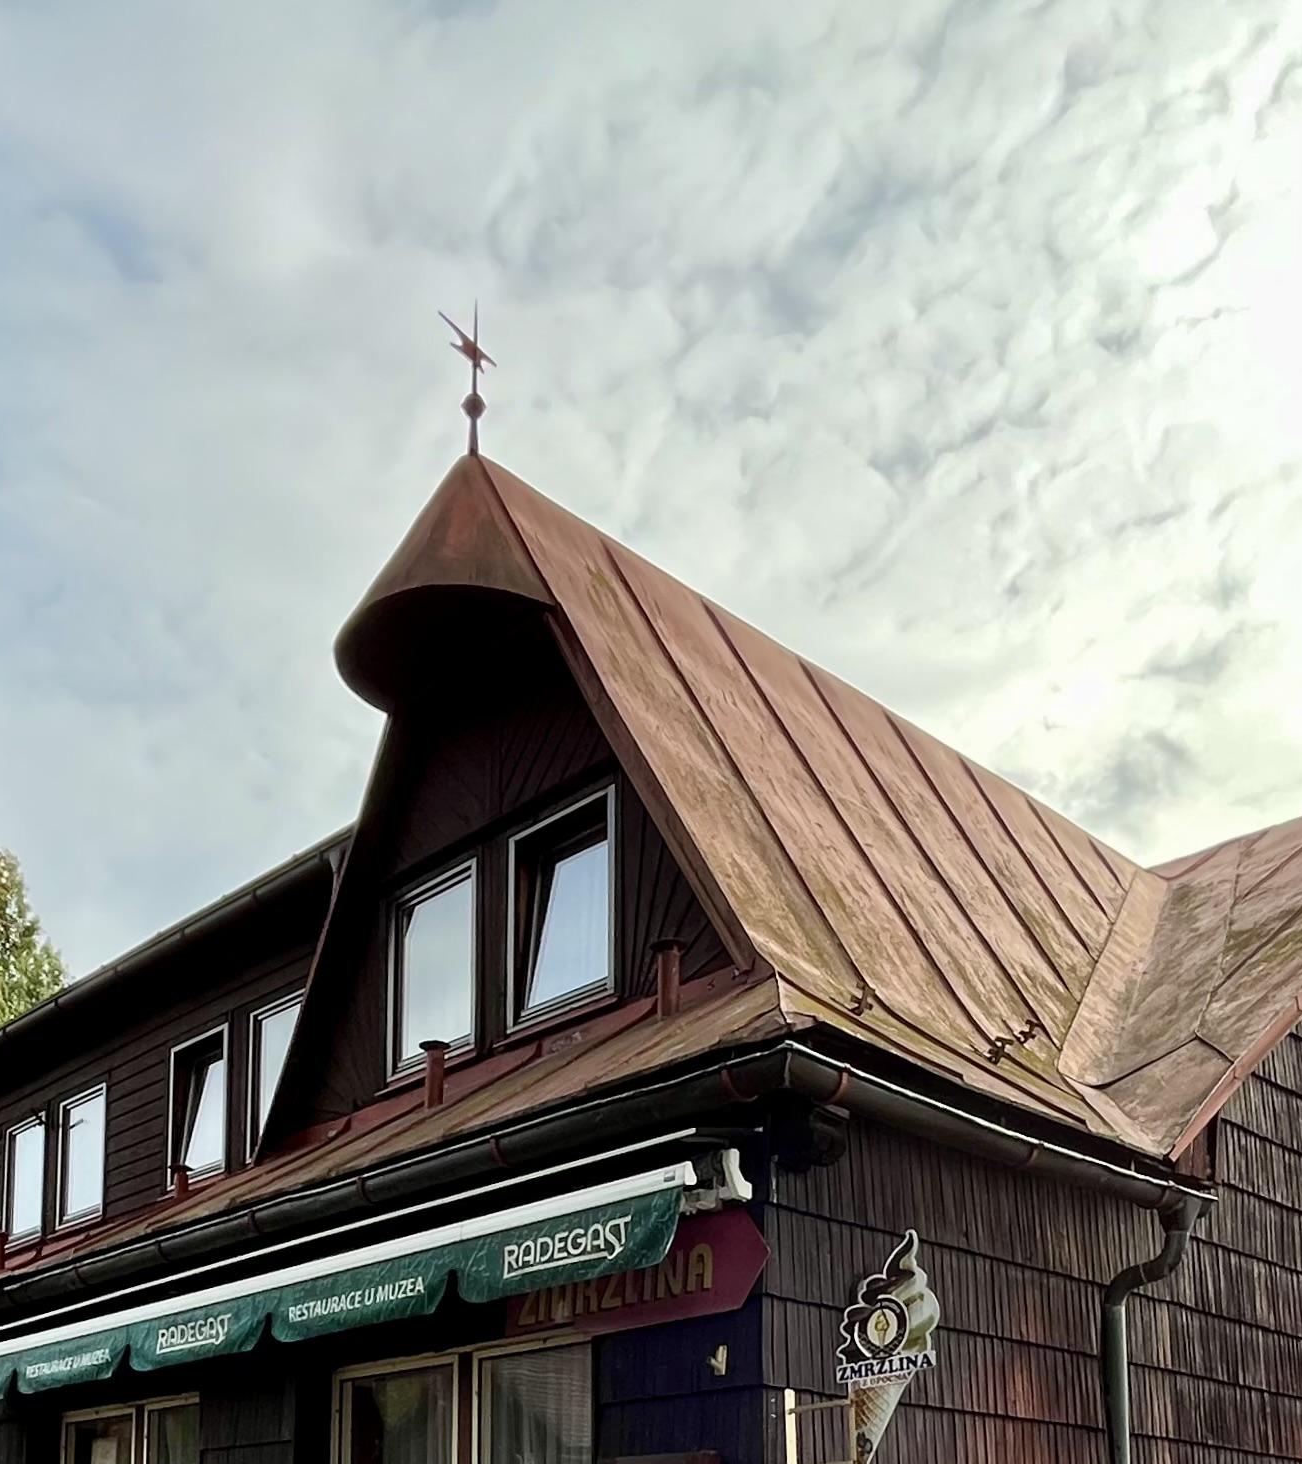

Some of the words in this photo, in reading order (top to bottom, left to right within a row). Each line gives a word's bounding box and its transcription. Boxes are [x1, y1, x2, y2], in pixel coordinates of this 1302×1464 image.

[502, 1214, 632, 1279] RADEGAST
[287, 1296, 362, 1324] RESTAURACE
[363, 1289, 376, 1308] U
[375, 1275, 425, 1304] MUZEA
[155, 1312, 233, 1356] RADEGAST
[838, 1353, 934, 1381] ZMRZLINA
